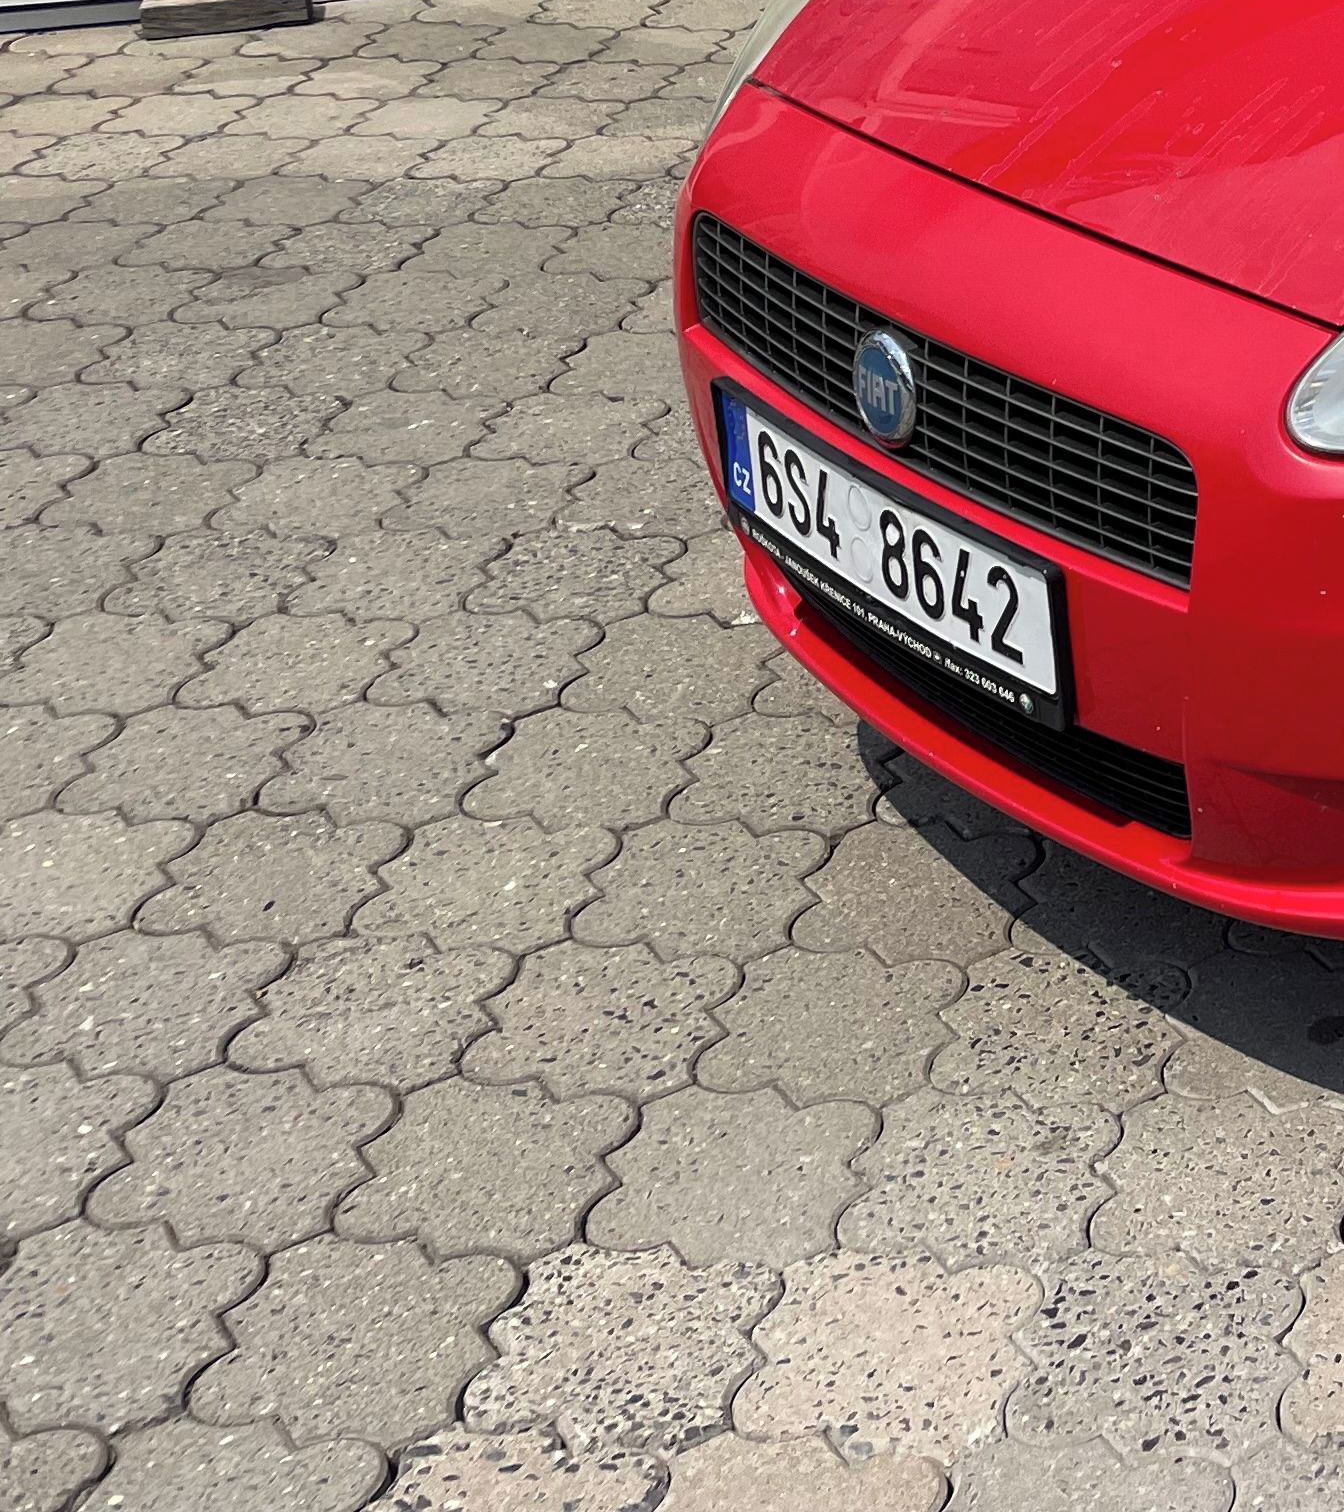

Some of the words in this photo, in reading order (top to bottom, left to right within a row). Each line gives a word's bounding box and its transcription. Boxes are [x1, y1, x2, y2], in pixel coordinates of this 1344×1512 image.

[857, 365, 900, 416] FIAT
[733, 460, 751, 496] CZ
[758, 430, 840, 560] 6S4
[880, 508, 1025, 666] 8642
